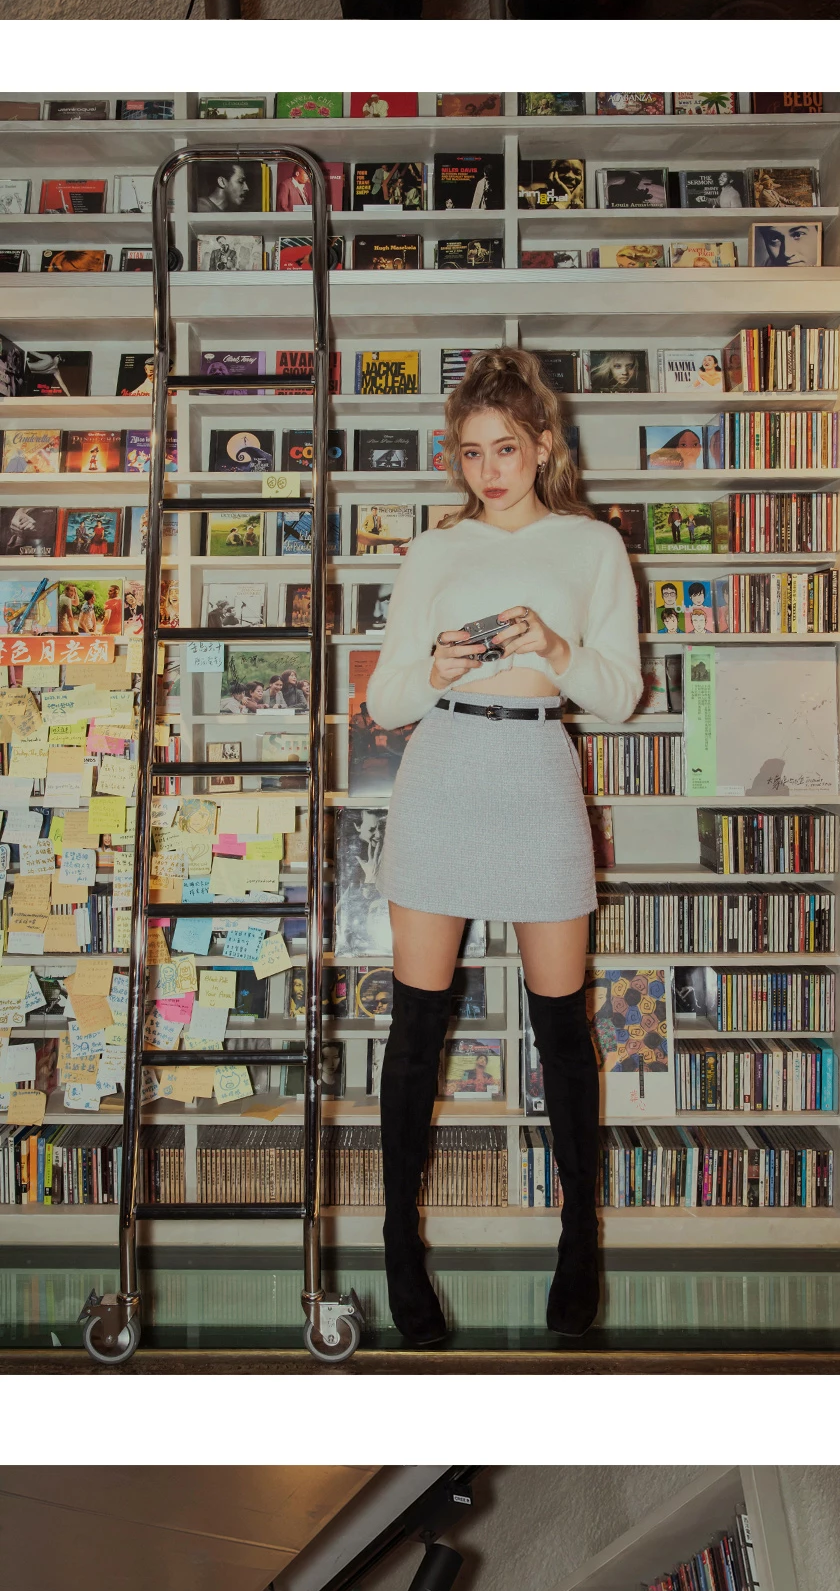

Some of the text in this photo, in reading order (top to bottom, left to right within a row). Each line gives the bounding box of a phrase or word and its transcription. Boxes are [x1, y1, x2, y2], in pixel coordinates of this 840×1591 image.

[607, 93, 653, 102] ALABANZA
[783, 93, 823, 107] BEBO
[668, 361, 696, 371] MAMMA
[674, 371, 691, 382] MIA!
[667, 544, 709, 552] PAPILLON
